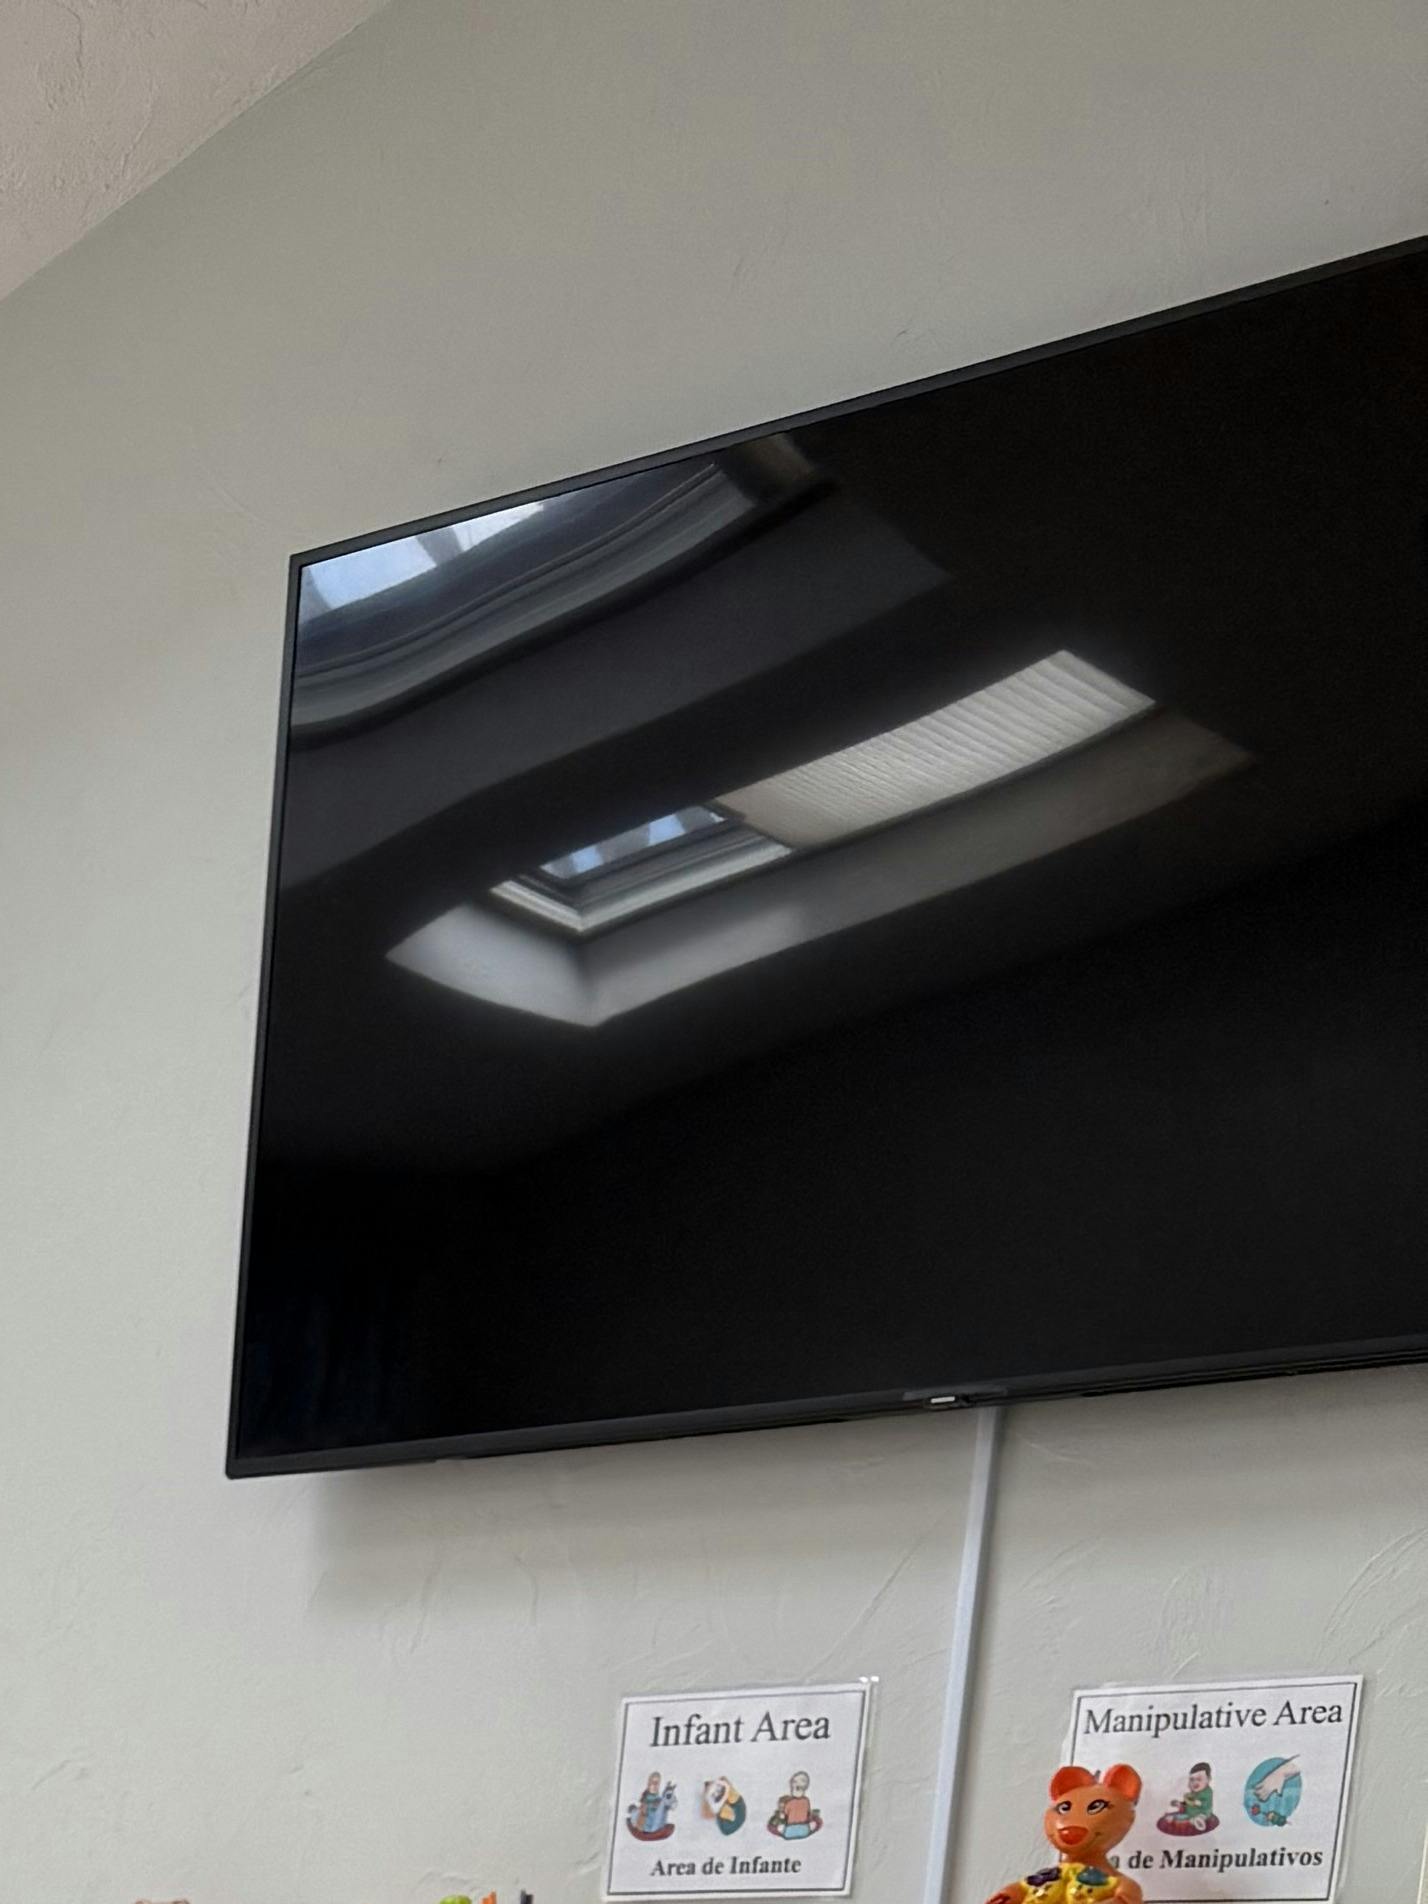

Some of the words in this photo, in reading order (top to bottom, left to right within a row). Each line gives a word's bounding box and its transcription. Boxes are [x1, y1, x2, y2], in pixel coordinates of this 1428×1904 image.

[649, 1713, 744, 1748] Infant
[750, 1711, 831, 1743] Area
[1082, 1702, 1267, 1738] Manipulative
[1273, 1700, 1343, 1726] Area
[650, 1858, 696, 1877] Area
[701, 1856, 725, 1875] de
[729, 1855, 803, 1875] Infante
[1128, 1849, 1154, 1869] de
[1158, 1847, 1324, 1873] Manipulativos
